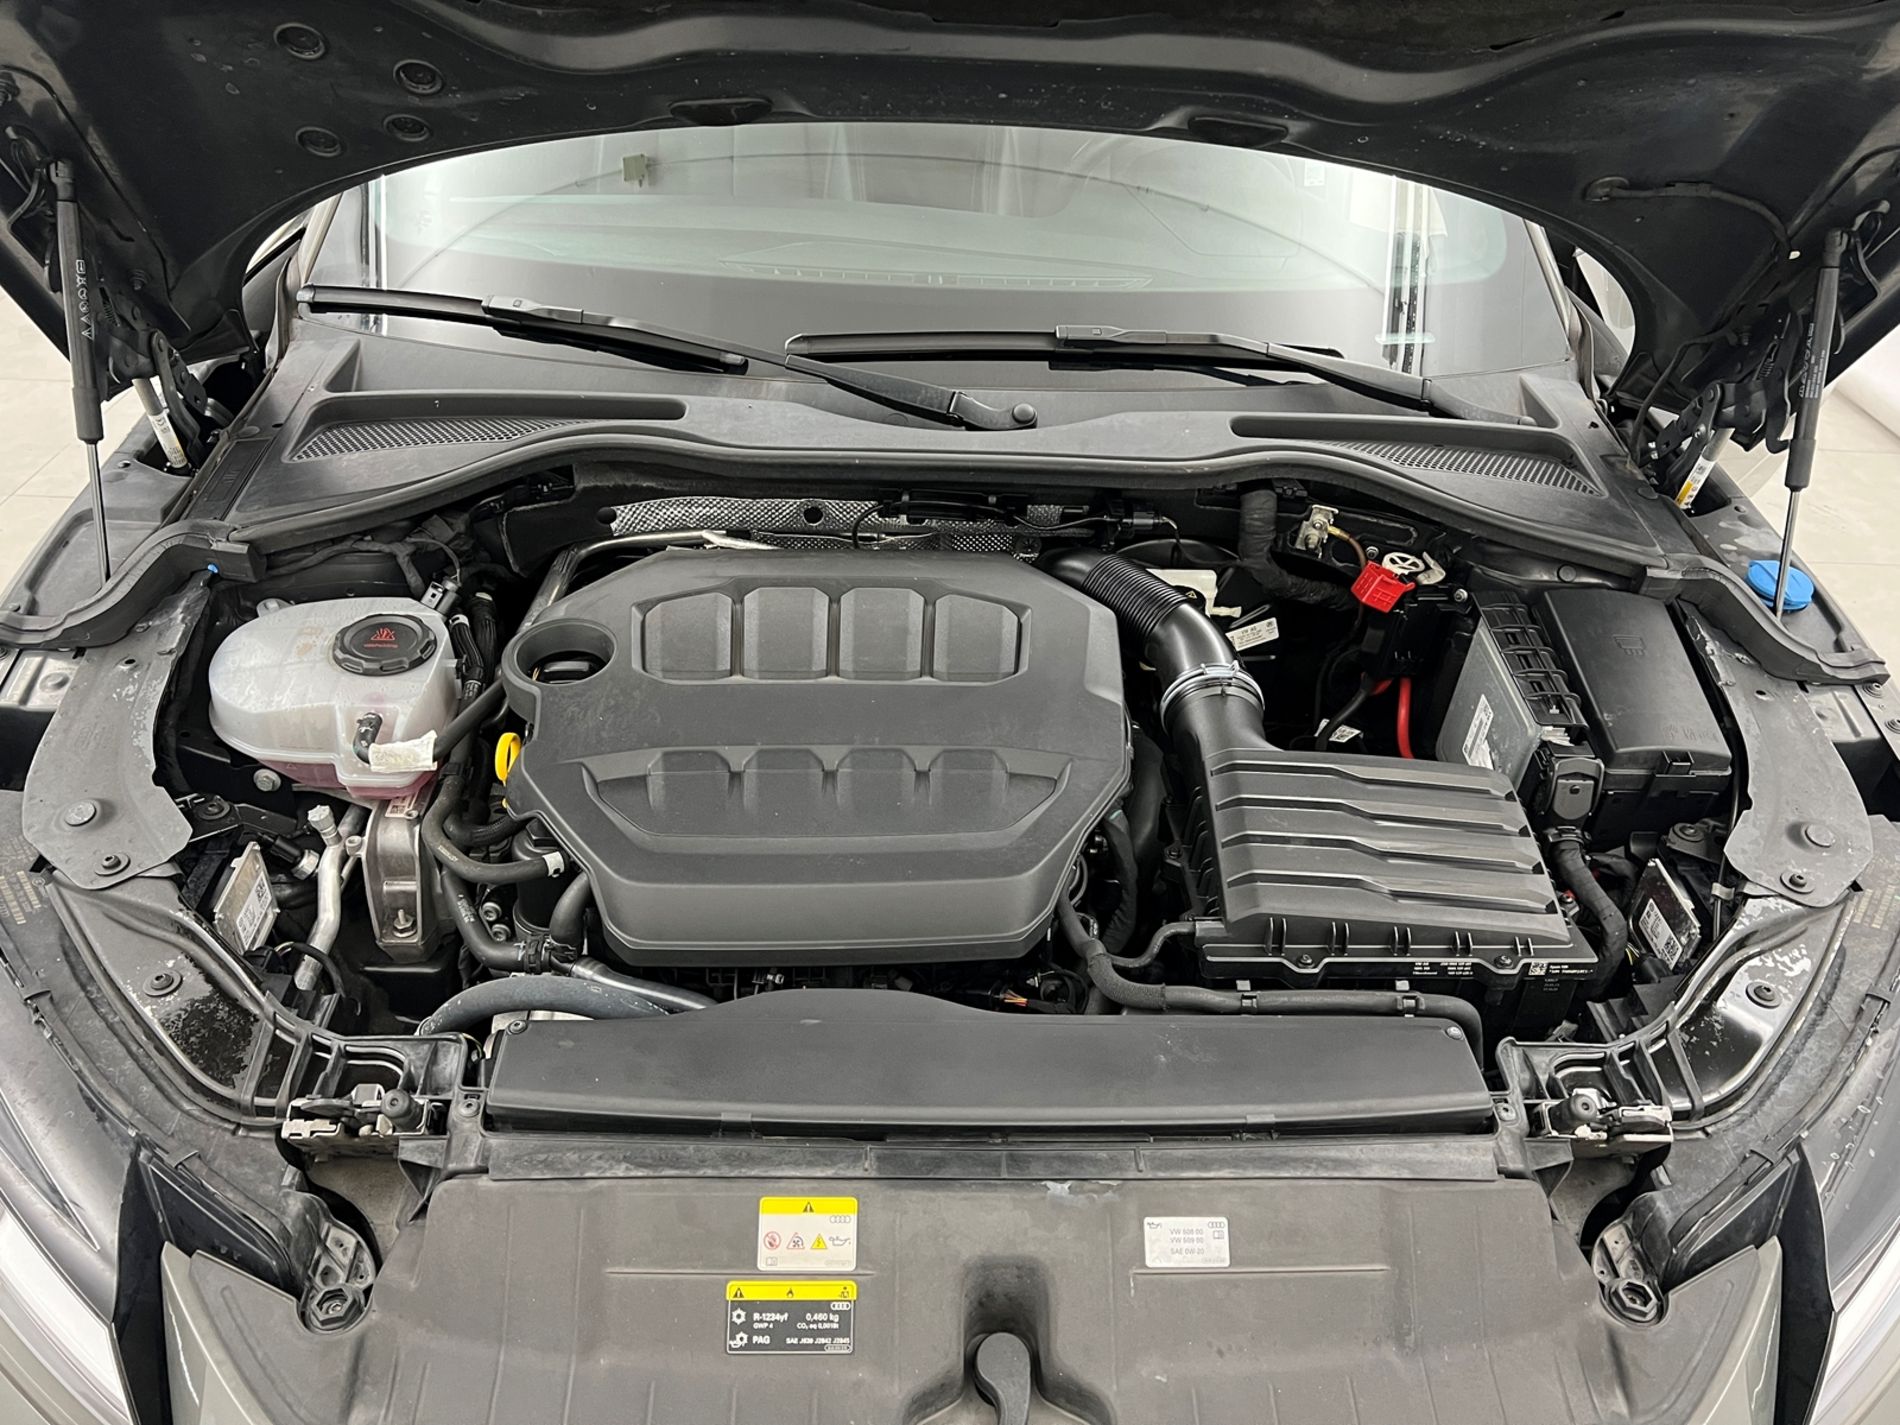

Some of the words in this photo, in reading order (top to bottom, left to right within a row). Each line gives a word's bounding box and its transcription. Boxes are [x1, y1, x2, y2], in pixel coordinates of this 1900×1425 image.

[753, 1312, 789, 1322] R-1234yf
[829, 1312, 839, 1322] kg
[752, 1335, 771, 1344] PAG
